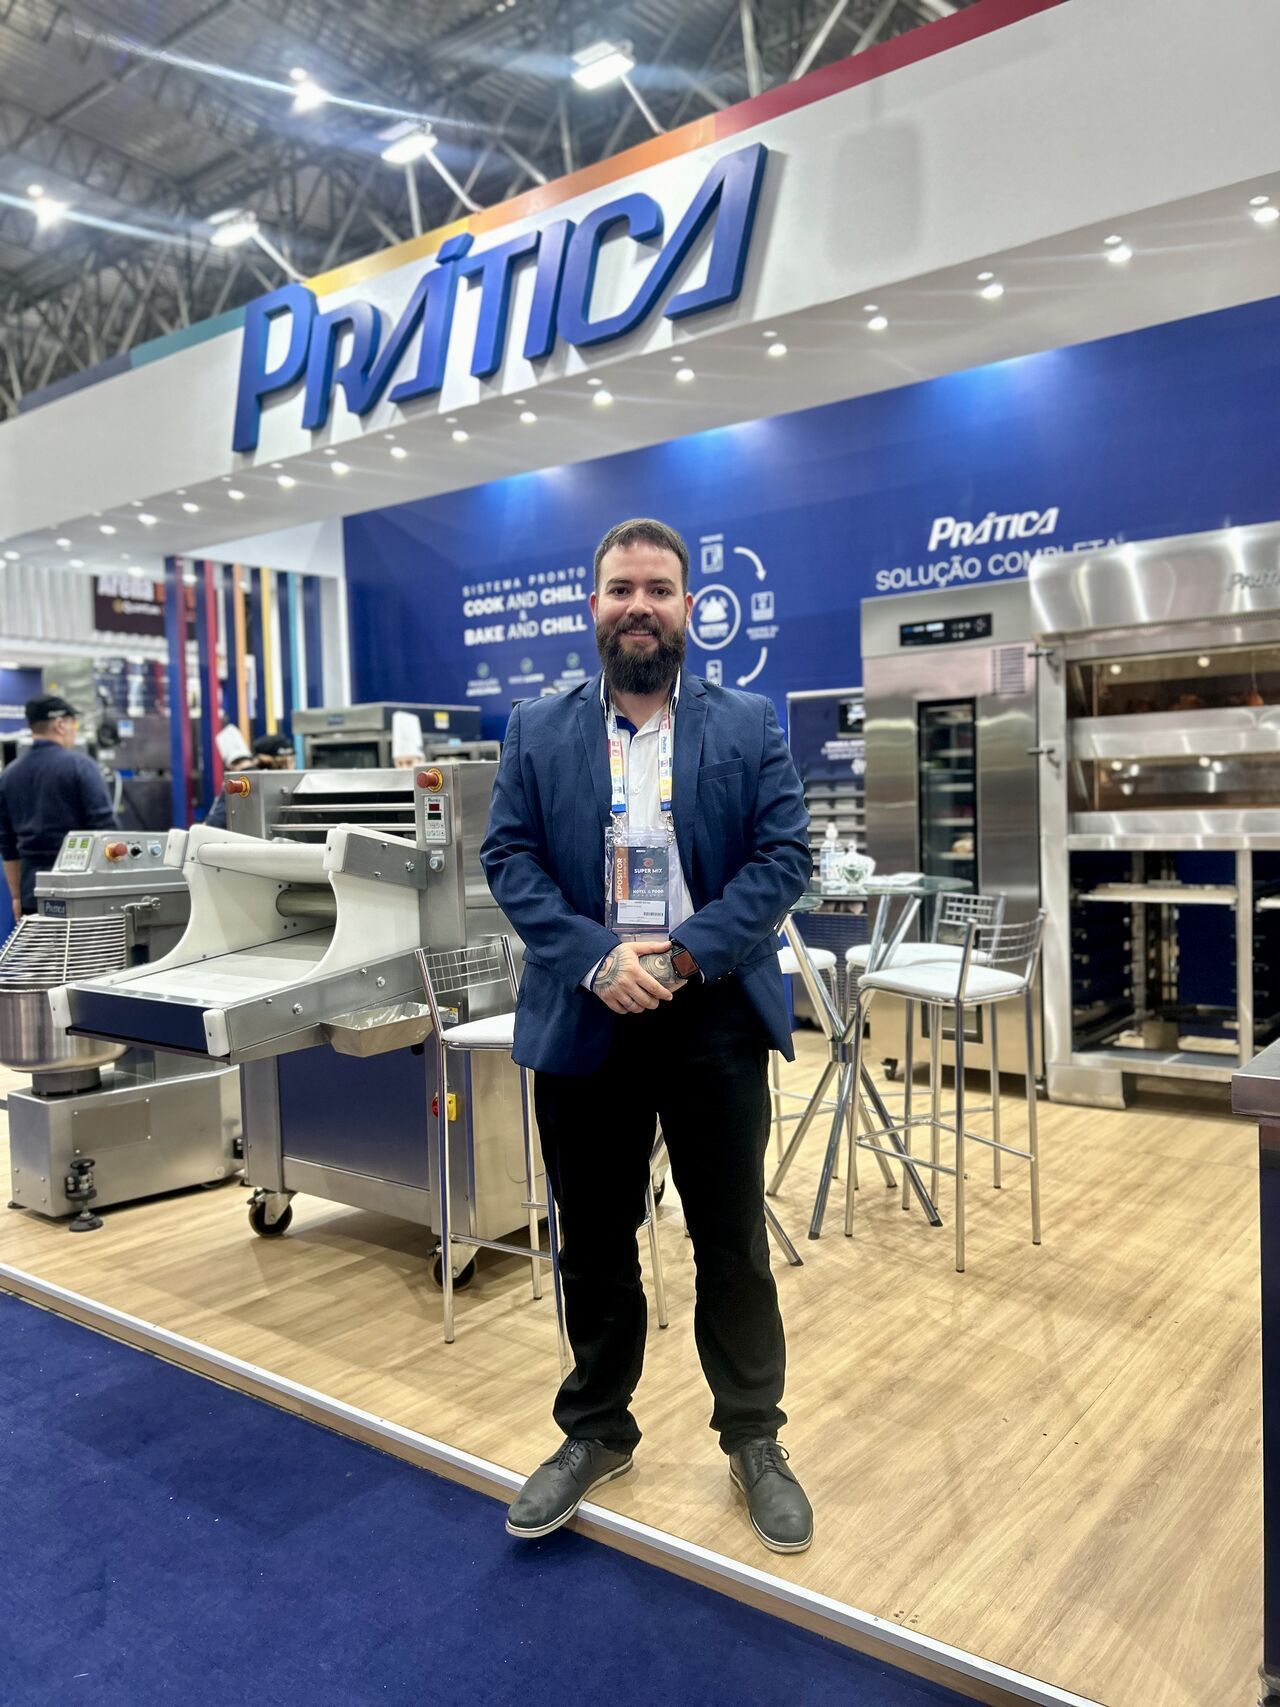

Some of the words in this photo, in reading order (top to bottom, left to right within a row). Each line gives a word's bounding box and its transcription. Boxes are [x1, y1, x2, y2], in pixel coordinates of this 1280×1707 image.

[232, 142, 767, 452] PRÁTICA
[927, 506, 1060, 552] PRÁTICA
[462, 577, 522, 597] SISTEMA
[528, 566, 586, 586] PRONTO
[875, 554, 982, 587] SOLUÇÃO
[463, 595, 505, 617] COOK
[506, 590, 539, 612] AND
[540, 583, 587, 606] CHILL
[464, 624, 506, 646] BAKE
[507, 620, 540, 641] AND
[541, 613, 588, 636] CHILL
